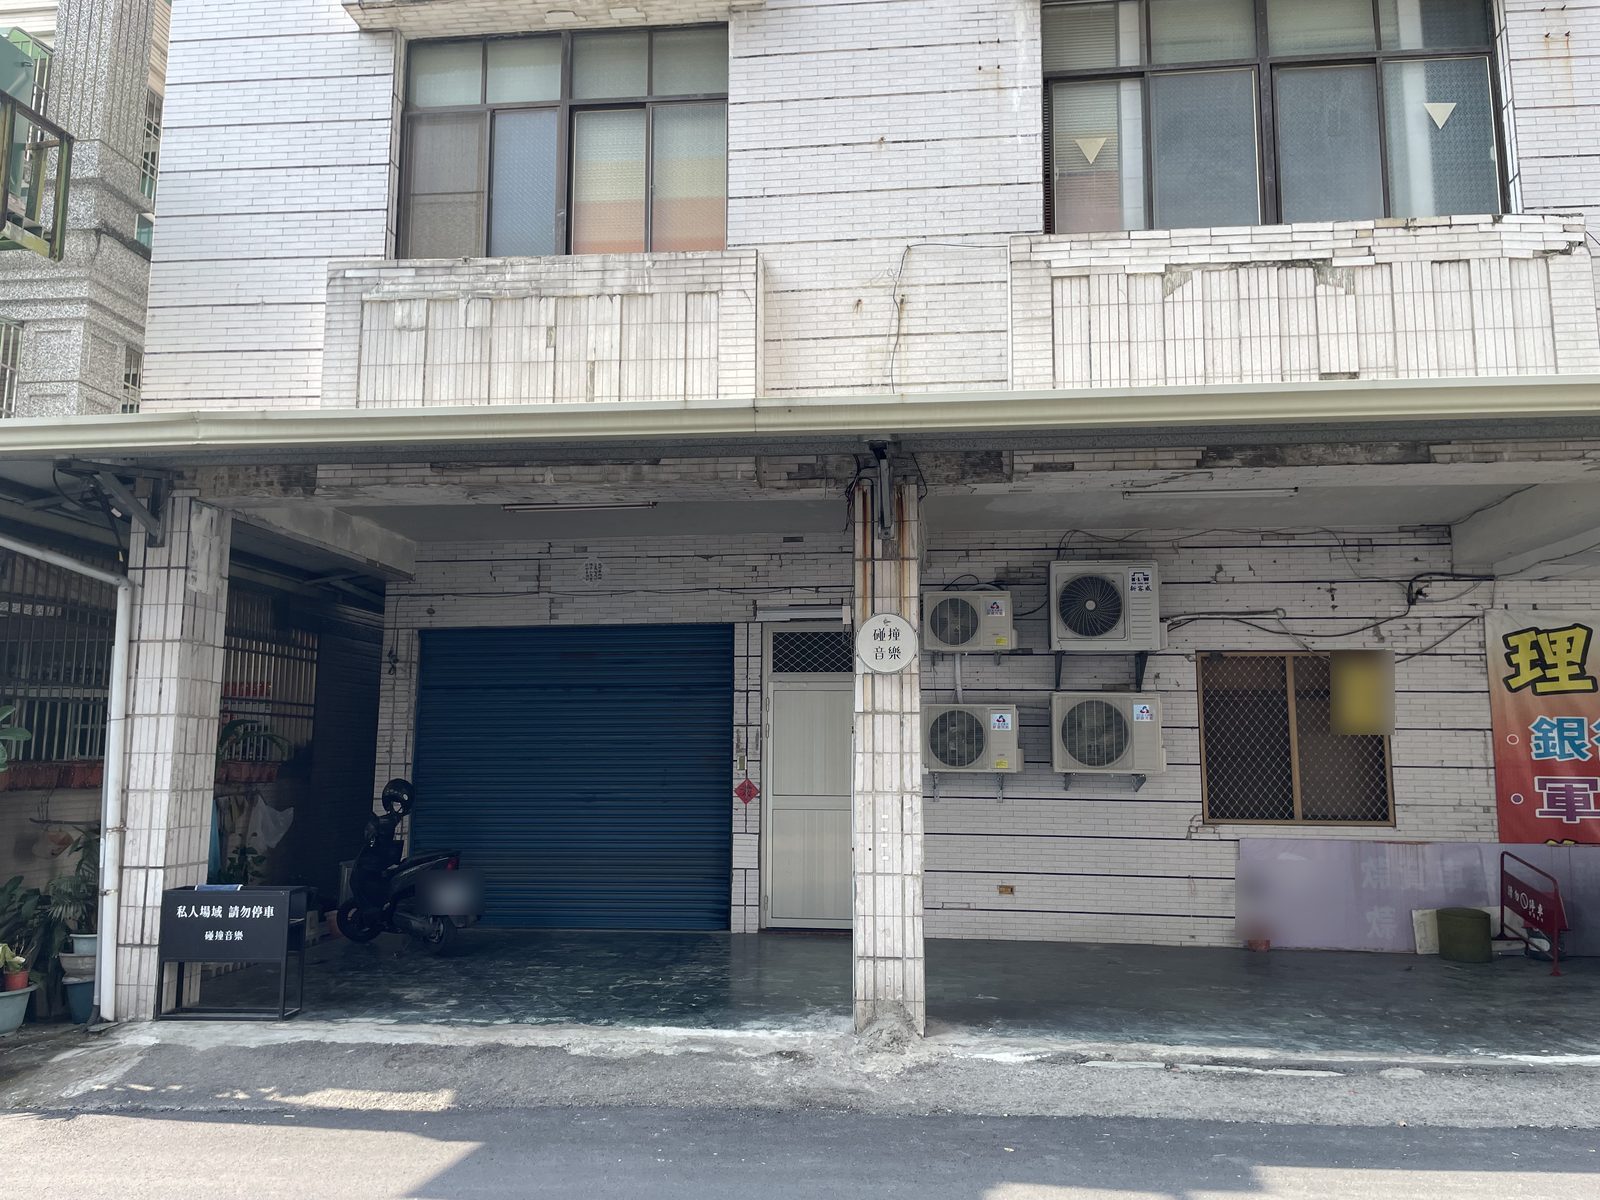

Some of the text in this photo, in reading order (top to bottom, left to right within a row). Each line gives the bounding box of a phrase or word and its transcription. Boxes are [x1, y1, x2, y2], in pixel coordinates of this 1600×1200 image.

[873, 627, 900, 641] 碰撞
[874, 646, 902, 660] 音樂
[1502, 623, 1599, 695] 理
[176, 905, 275, 919] 私人場域 請勿停車
[204, 930, 244, 941] 碰撞音樂
